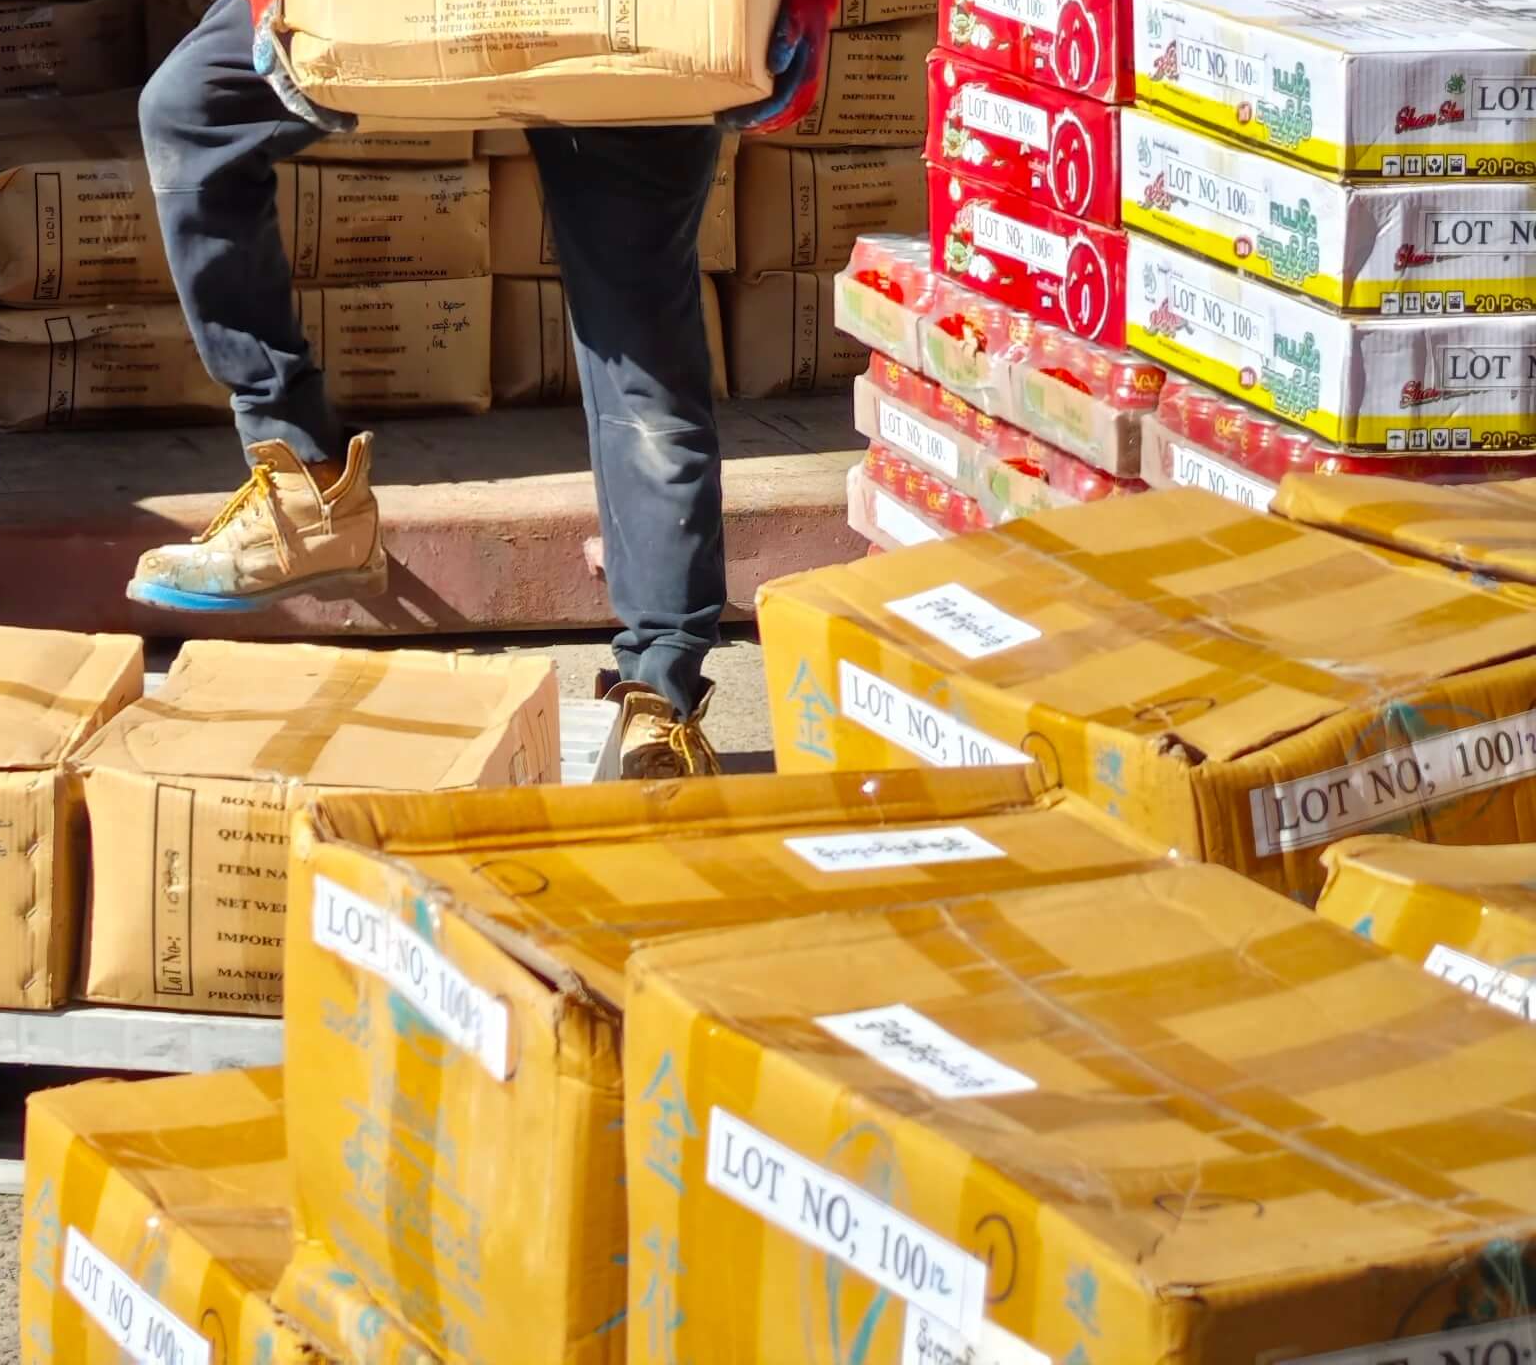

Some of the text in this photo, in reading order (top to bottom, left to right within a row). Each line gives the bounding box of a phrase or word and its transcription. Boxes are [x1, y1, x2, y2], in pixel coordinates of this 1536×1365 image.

[848, 33, 902, 42] QUANTITY
[1178, 44, 1229, 83] LOT NO;
[866, 73, 909, 82] WEIGHT
[967, 98, 987, 119] LOT
[1478, 85, 1536, 111] LOT
[1476, 157, 1535, 177] 20 Pcs
[1168, 163, 1222, 210] LOT NO;
[978, 212, 997, 234] LOT
[1431, 219, 1493, 245] LOT
[1172, 283, 1226, 332] LOT NO;
[1475, 294, 1532, 314] 20 Pcs
[1449, 355, 1511, 380] LOT
[1480, 432, 1503, 449] 20
[1178, 453, 1199, 479] LOT
[851, 673, 949, 769] LOT NO;
[221, 795, 257, 809] BOX
[1272, 785, 1348, 833] LOT
[1369, 758, 1436, 806] NO;
[217, 863, 262, 879] ITEM
[216, 896, 252, 911] NET
[326, 894, 431, 993] LOT NO;
[723, 1129, 786, 1205] LOT
[799, 1176, 862, 1259] NO;
[70, 1244, 104, 1302] LOT
